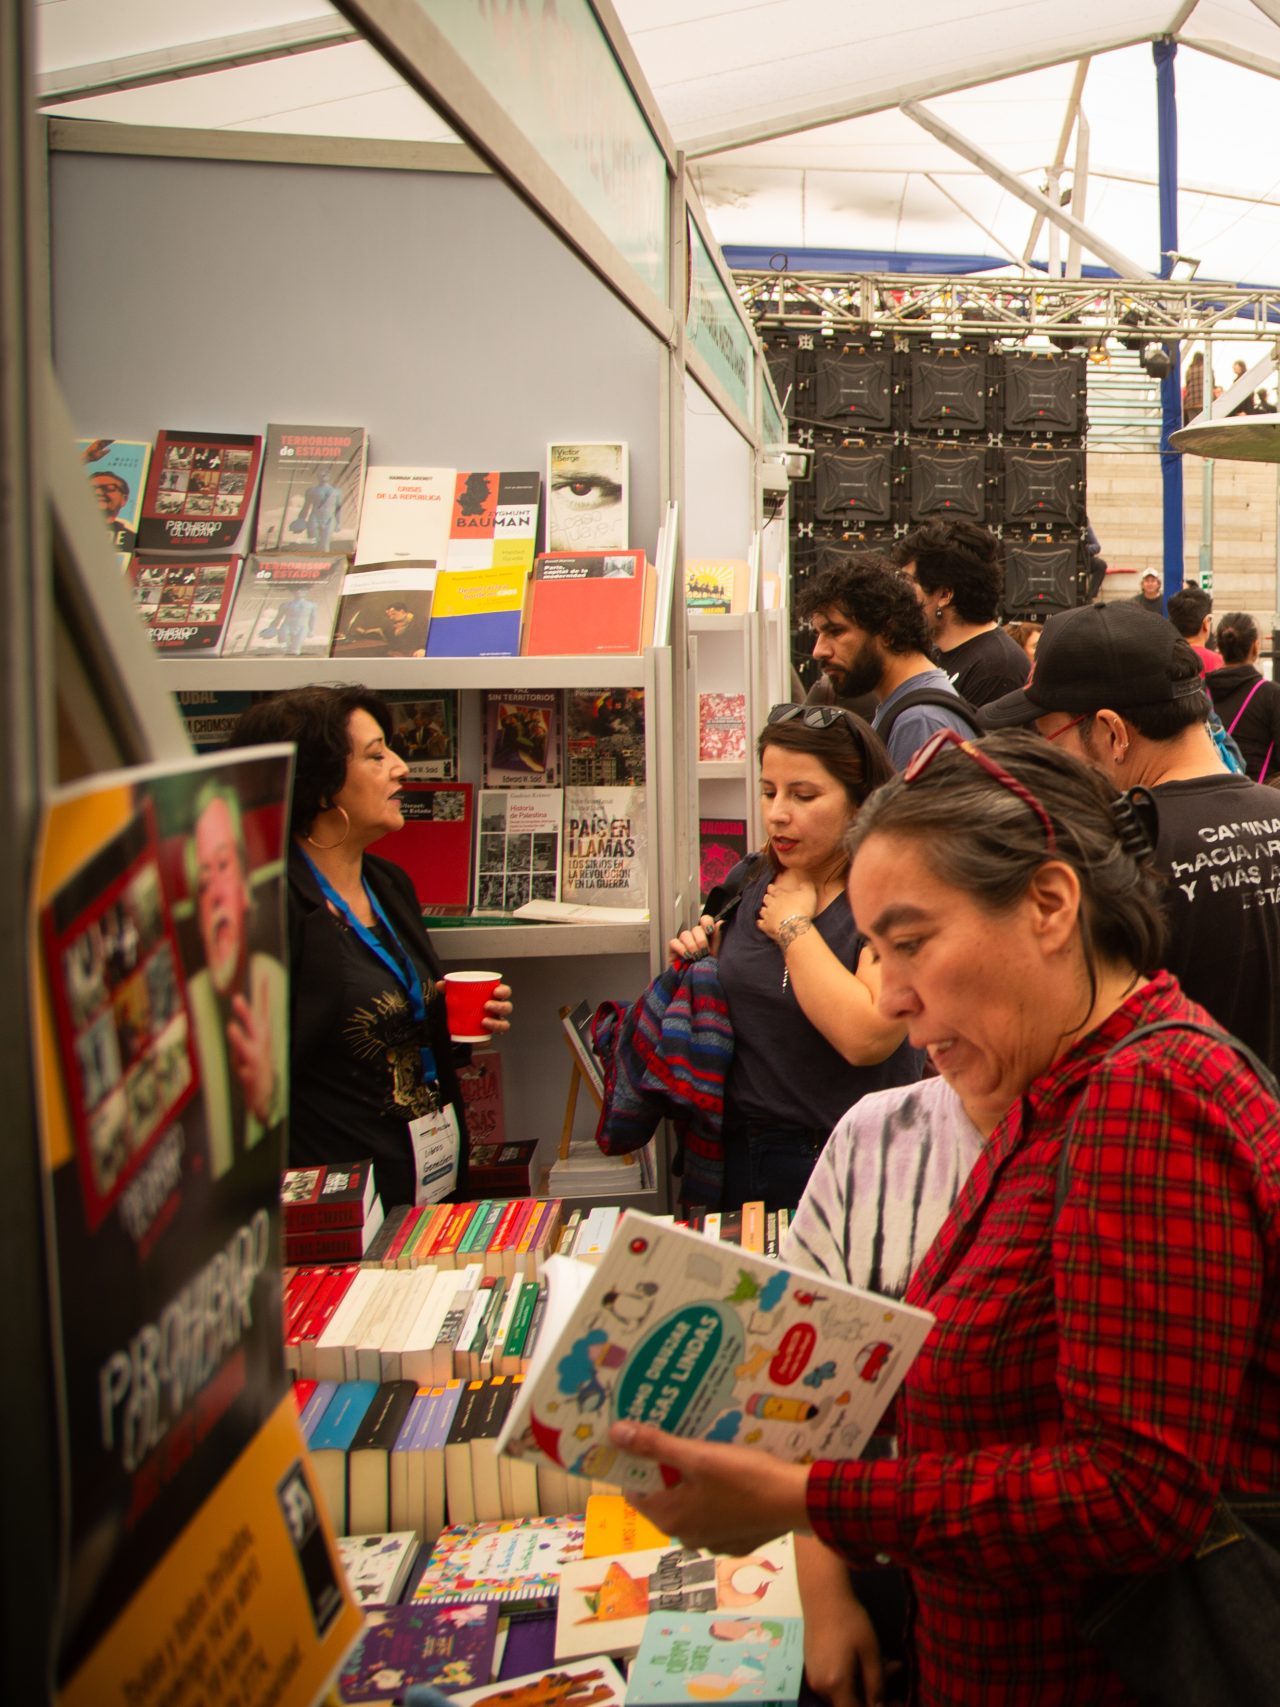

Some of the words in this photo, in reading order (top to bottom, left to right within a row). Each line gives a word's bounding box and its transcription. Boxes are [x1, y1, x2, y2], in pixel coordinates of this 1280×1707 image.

[281, 435, 352, 447] TERRORISMO
[280, 446, 294, 456] de
[165, 520, 222, 531] PROHIBIDO
[456, 517, 530, 528] BAUMAN
[170, 527, 215, 537] OLVIDAR
[258, 561, 332, 571] TERRORISMO
[256, 570, 272, 579] de
[146, 627, 198, 636] ROHIBIDO
[504, 694, 556, 702] TERRITORIOS
[530, 775, 542, 783] Said
[570, 813, 608, 838] PAÍS
[610, 818, 631, 838] EN
[570, 839, 635, 858] LLAMAS
[569, 860, 584, 869] LOS
[585, 860, 612, 869] SIRIOS
[613, 860, 624, 869] EN
[569, 869, 578, 879] LA
[569, 879, 575, 889] Y
[575, 879, 585, 889] EN
[586, 879, 595, 889] LA
[596, 879, 630, 889] GUERRA
[1179, 880, 1198, 903] Y
[646, 1320, 691, 1380] DIBUJAR
[645, 1383, 680, 1426] OSAS
[676, 1314, 719, 1383] LINDAS
